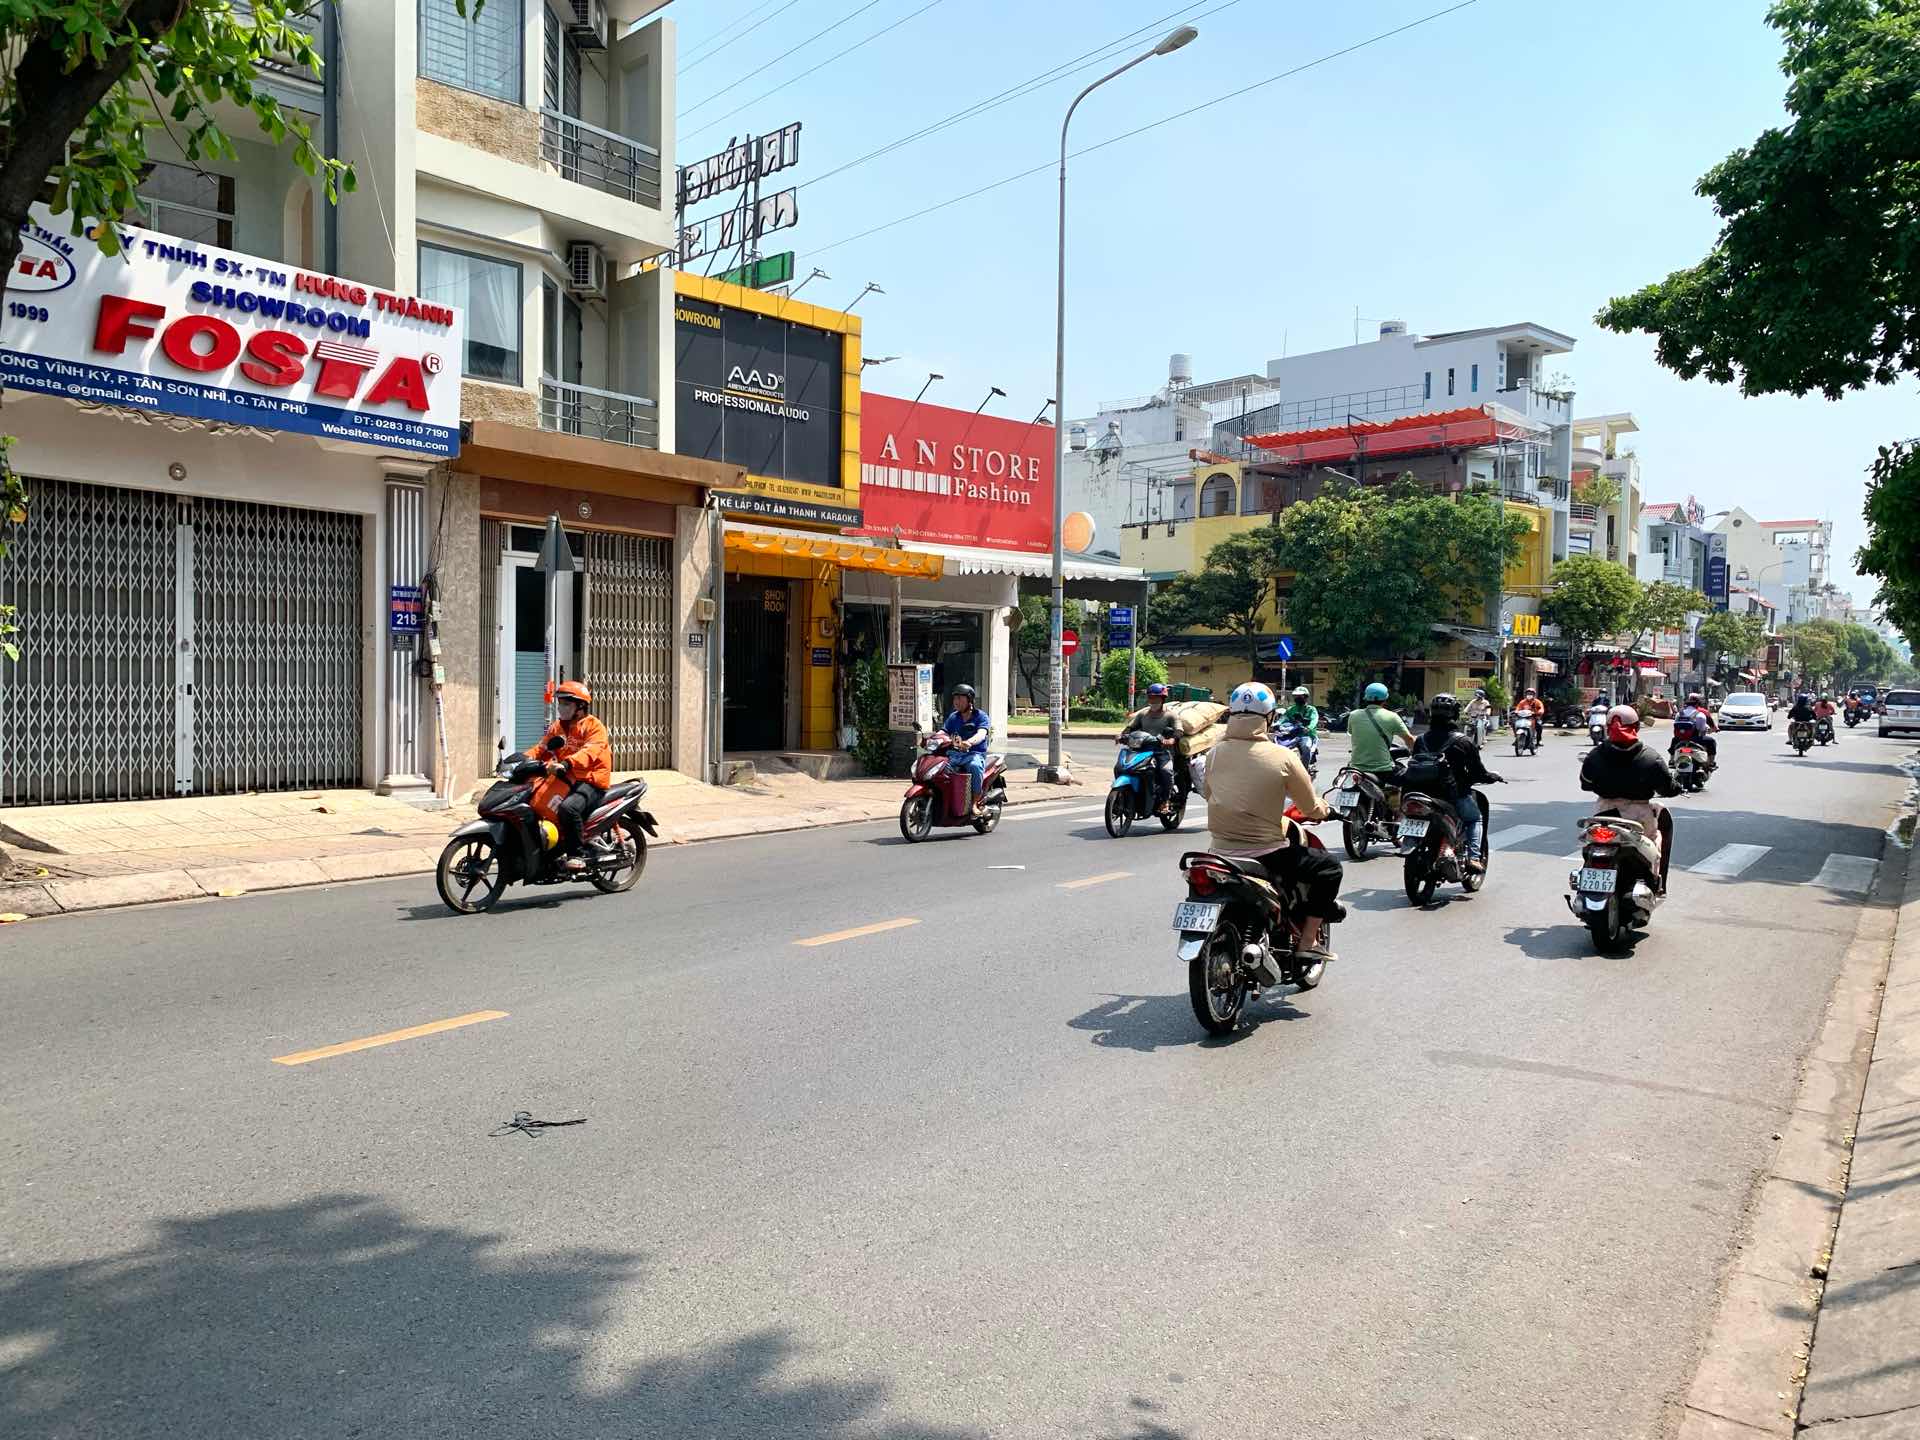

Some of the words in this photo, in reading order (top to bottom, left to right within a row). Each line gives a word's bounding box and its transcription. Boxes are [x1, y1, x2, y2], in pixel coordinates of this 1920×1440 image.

[143, 240, 208, 268] TNHH
[373, 290, 454, 326] THÀNH
[9, 301, 49, 322] 1999
[191, 281, 370, 338] SHOWROOM
[94, 295, 431, 412] FOSTA
[45, 361, 84, 377] VĨNH
[118, 374, 129, 385] P.
[167, 382, 199, 397] SƠN
[234, 394, 249, 407] Q.
[281, 399, 308, 415] PHÚ
[375, 418, 403, 431] 0283
[405, 424, 423, 435] 810
[426, 427, 448, 439] 7190
[952, 444, 1040, 482] STORE
[953, 477, 1031, 505] Fashion
[789, 506, 817, 518] THANH
[820, 512, 858, 524] KARAOKE
[396, 613, 417, 625] 218
